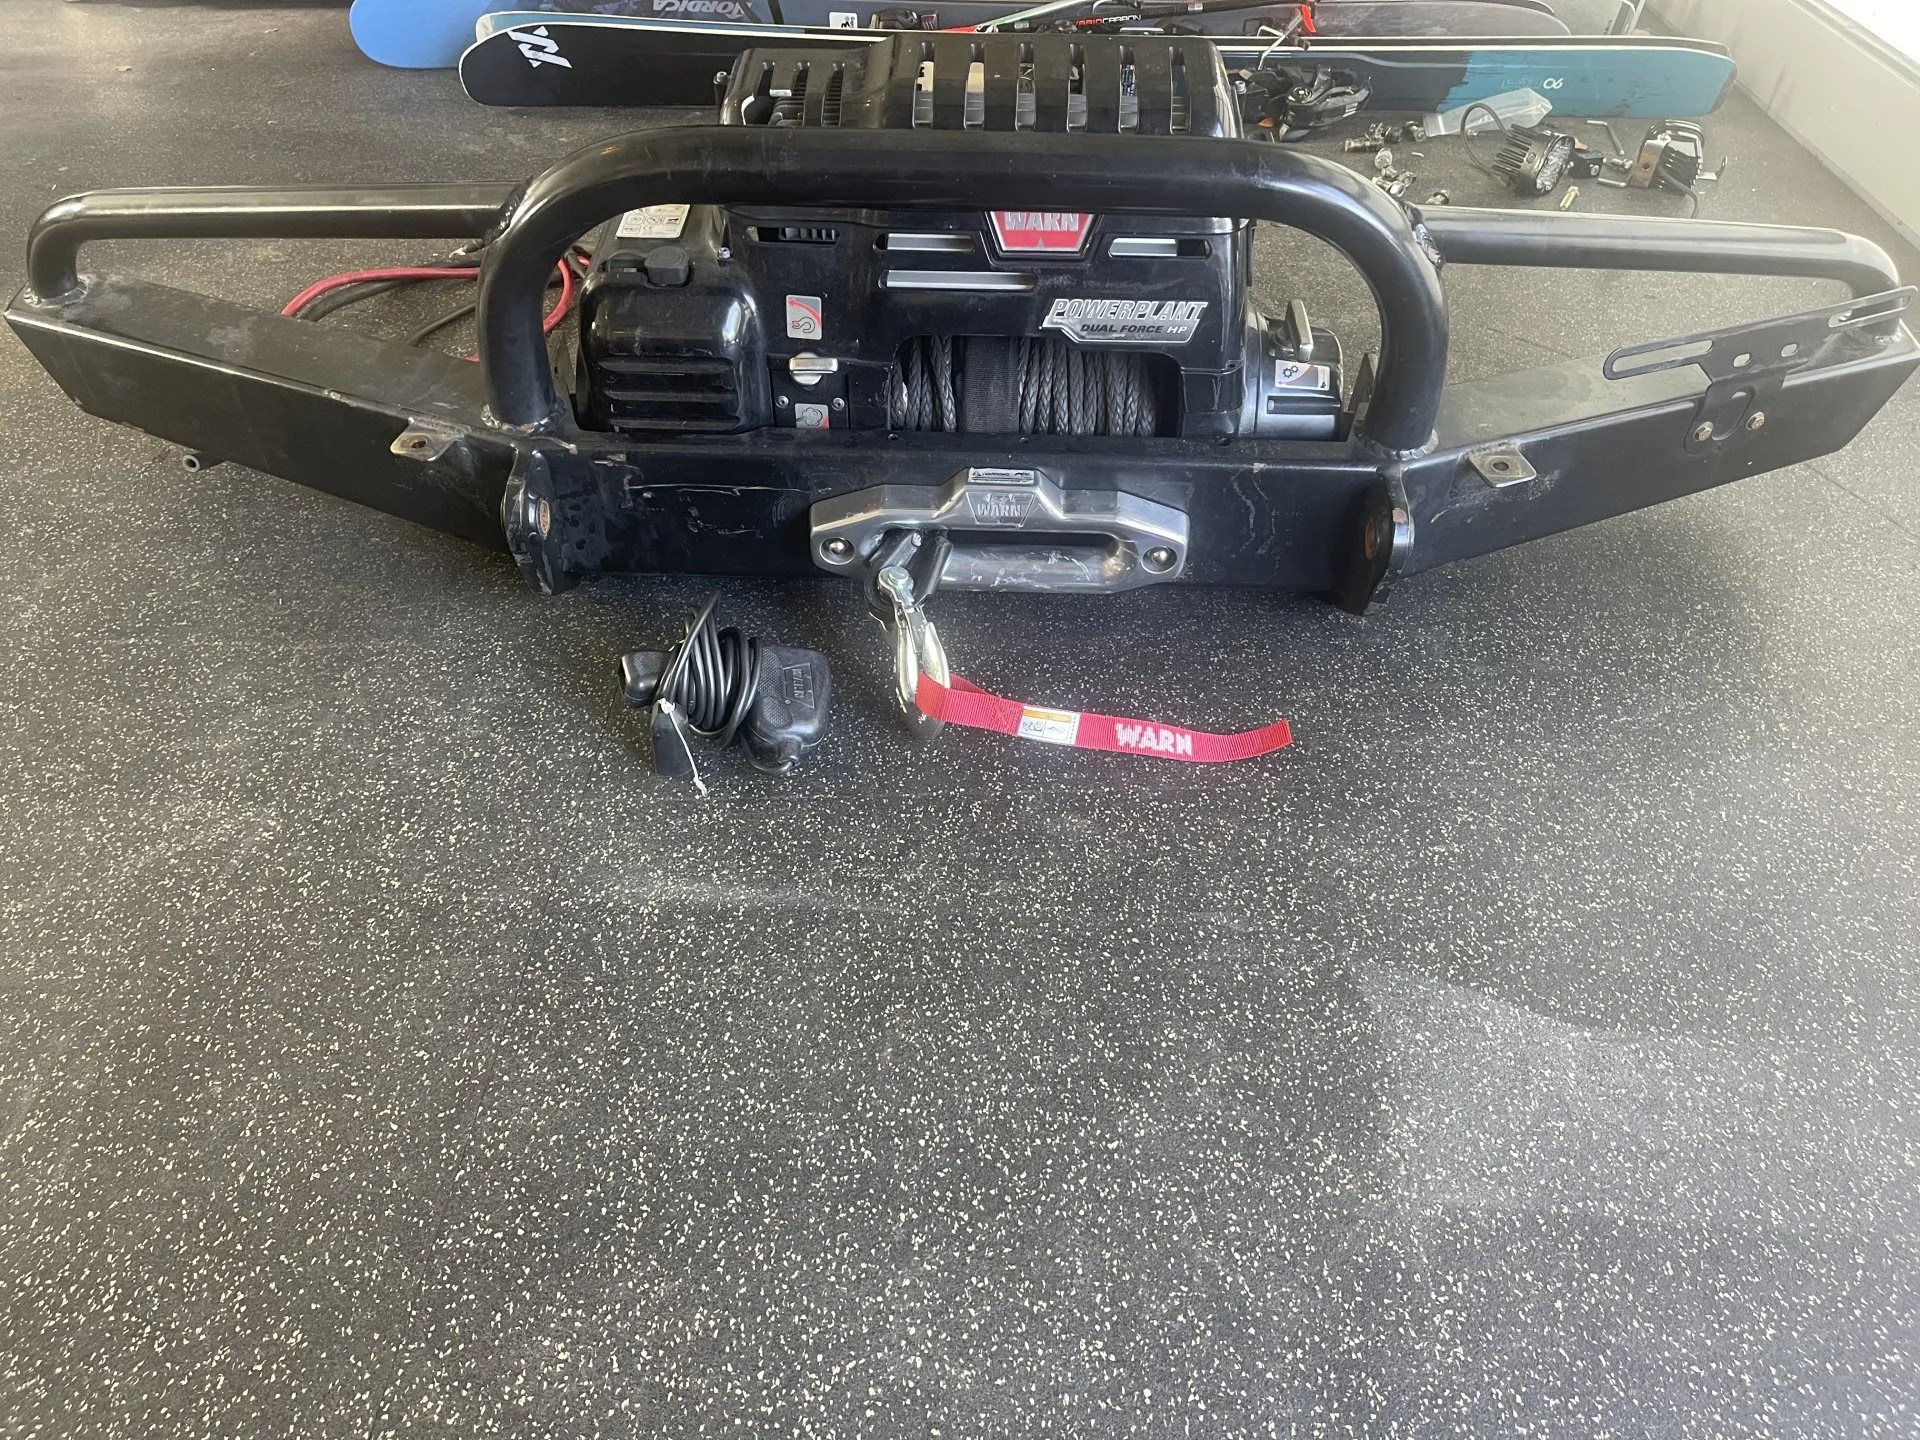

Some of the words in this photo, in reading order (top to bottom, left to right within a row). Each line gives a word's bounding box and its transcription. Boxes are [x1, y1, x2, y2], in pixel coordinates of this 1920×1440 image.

[1004, 210, 1080, 231] WARN
[1052, 298, 1208, 322] POWERPLANT
[1080, 323, 1118, 333] DUAL
[1120, 324, 1165, 334] FORCE
[1166, 325, 1188, 335] HP
[977, 503, 1021, 517] WARN
[792, 668, 805, 699] WARN
[1115, 722, 1193, 756] WARN
